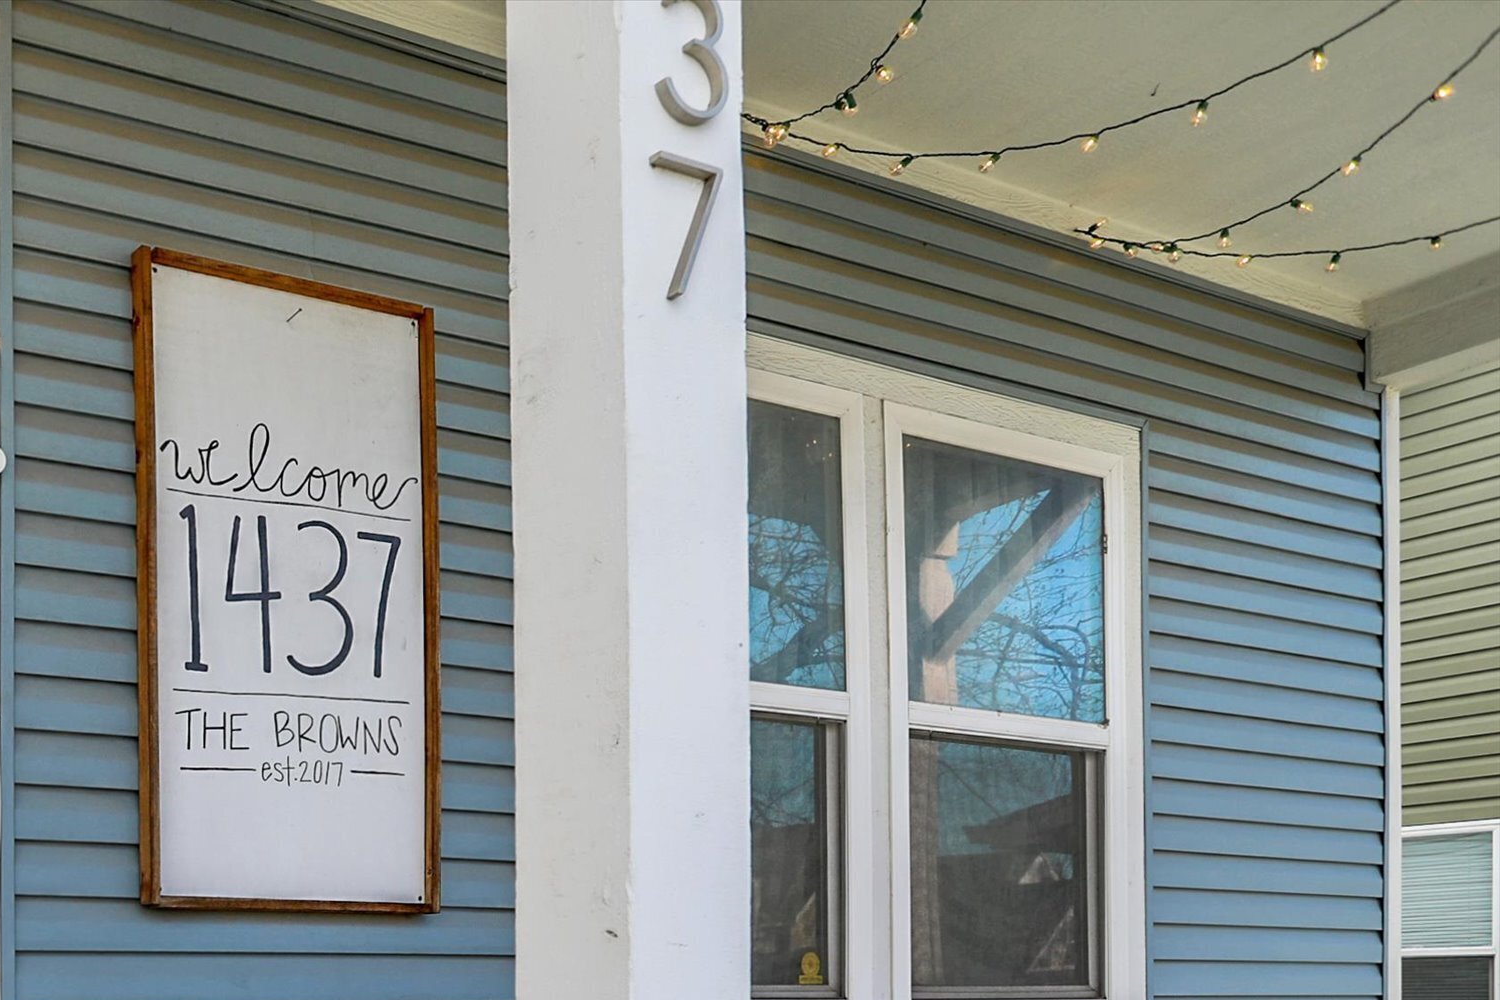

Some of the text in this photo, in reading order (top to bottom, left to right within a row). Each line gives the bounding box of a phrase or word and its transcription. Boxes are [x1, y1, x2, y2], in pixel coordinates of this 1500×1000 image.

[649, 0, 729, 300] 37
[160, 423, 418, 509] welcome
[179, 503, 401, 678] 1437
[175, 708, 403, 755] THE BROWNS
